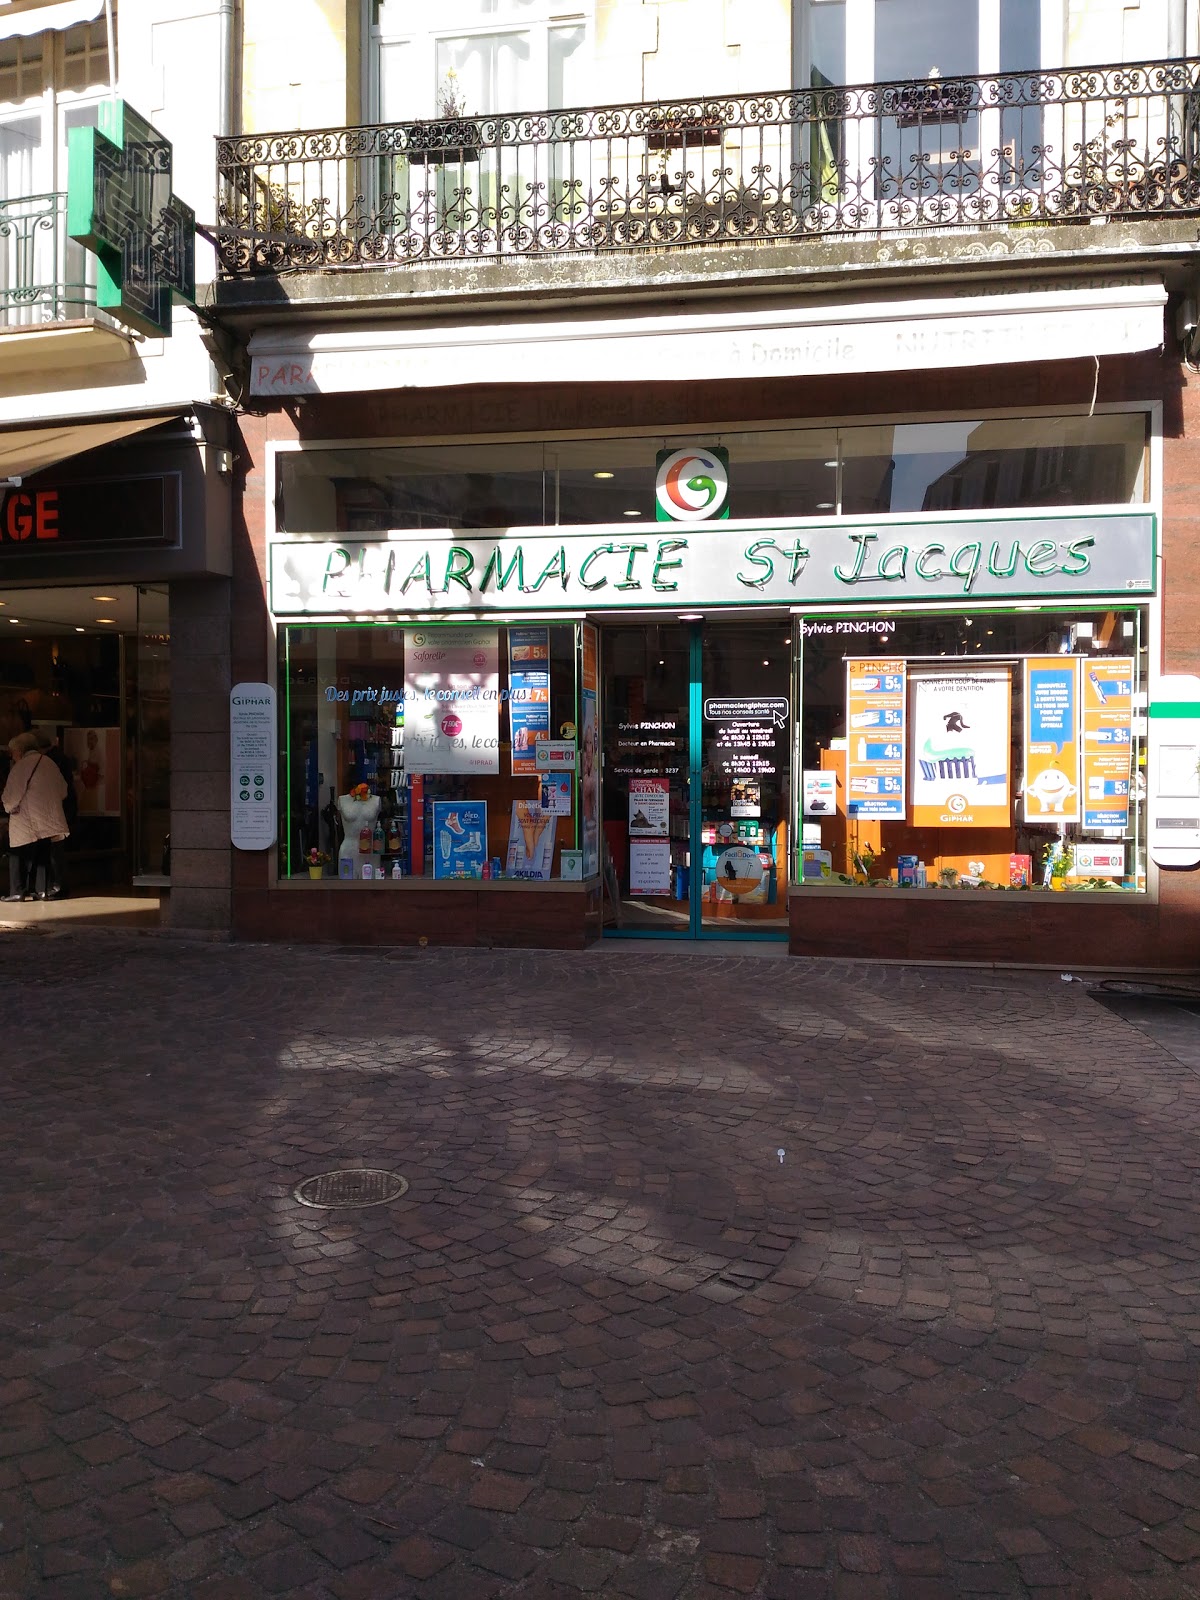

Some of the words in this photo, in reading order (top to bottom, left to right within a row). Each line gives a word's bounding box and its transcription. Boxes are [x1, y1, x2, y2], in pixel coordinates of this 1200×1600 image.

[0, 491, 60, 542] GE
[322, 537, 690, 598] PHARMACIE
[737, 537, 809, 590] St
[834, 532, 1096, 593] Jacques
[801, 622, 834, 637] Sylvie
[835, 621, 896, 634] PINCHON
[412, 650, 446, 663] Saforelle
[231, 696, 271, 706] GIPHAR
[324, 685, 349, 703] Des
[351, 688, 378, 707] prix
[377, 687, 419, 707] justes,
[424, 686, 437, 702] le
[437, 686, 482, 702] conseil
[483, 690, 498, 702] en
[708, 702, 785, 710] pharmaciengiphar.com
[618, 723, 639, 731] Sylvie
[640, 721, 676, 730] PINCHON
[643, 768, 659, 776] garde
[939, 814, 974, 823] GIPHAR
